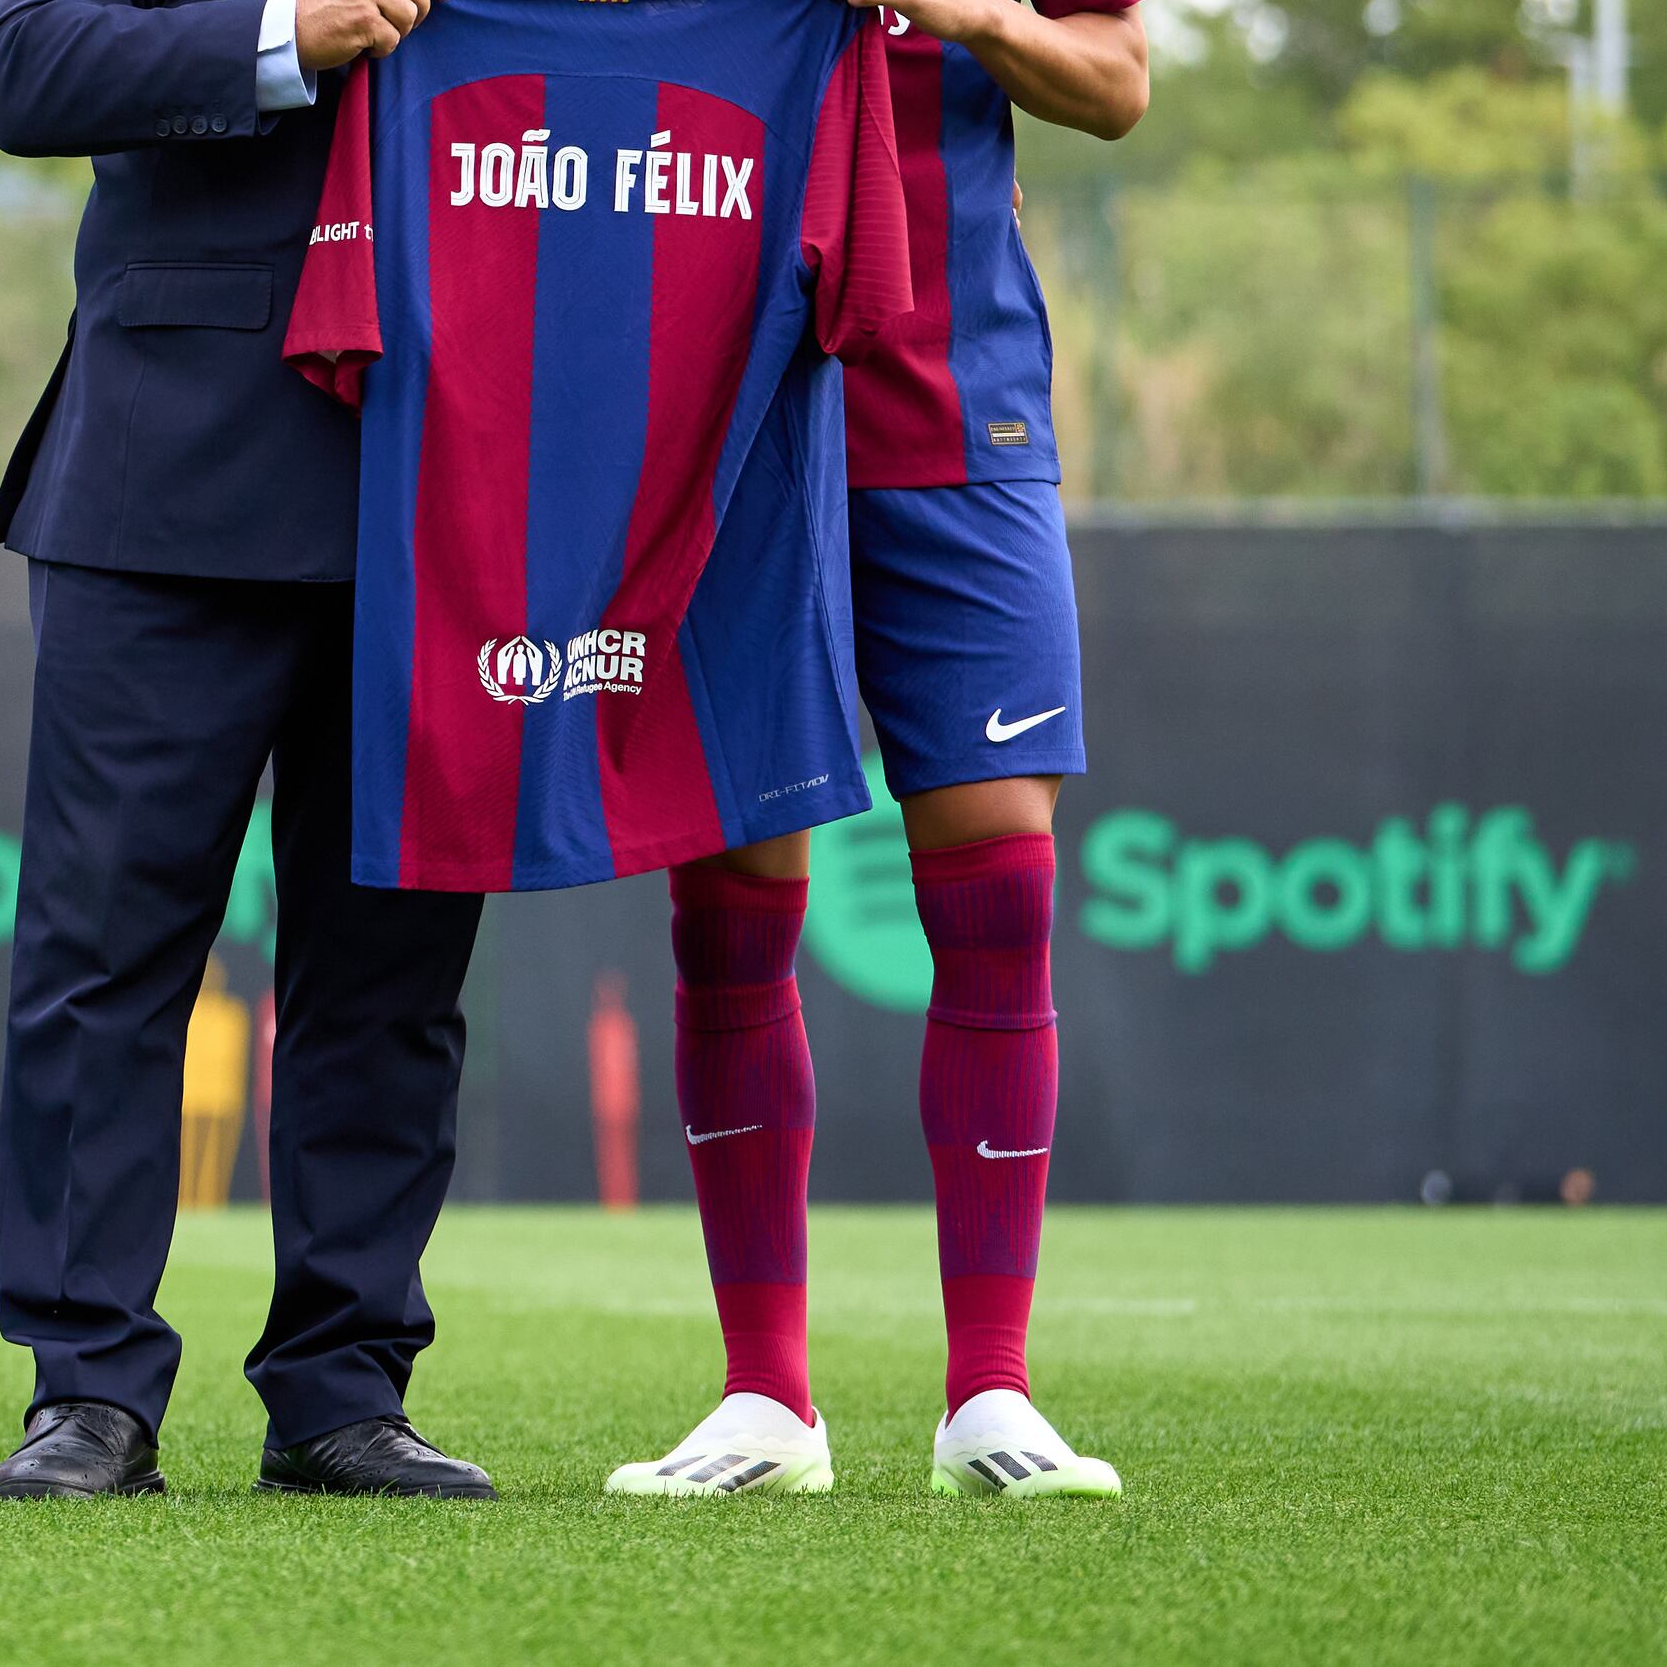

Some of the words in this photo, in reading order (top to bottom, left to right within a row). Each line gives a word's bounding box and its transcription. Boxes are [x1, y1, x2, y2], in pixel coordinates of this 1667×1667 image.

[450, 129, 588, 211] JOÃO
[614, 130, 754, 220] FÉLIX
[567, 629, 646, 663] UNHCR
[563, 655, 644, 690] ACNUR
[603, 681, 642, 695] Agency
[1079, 801, 1605, 974] Spotify
